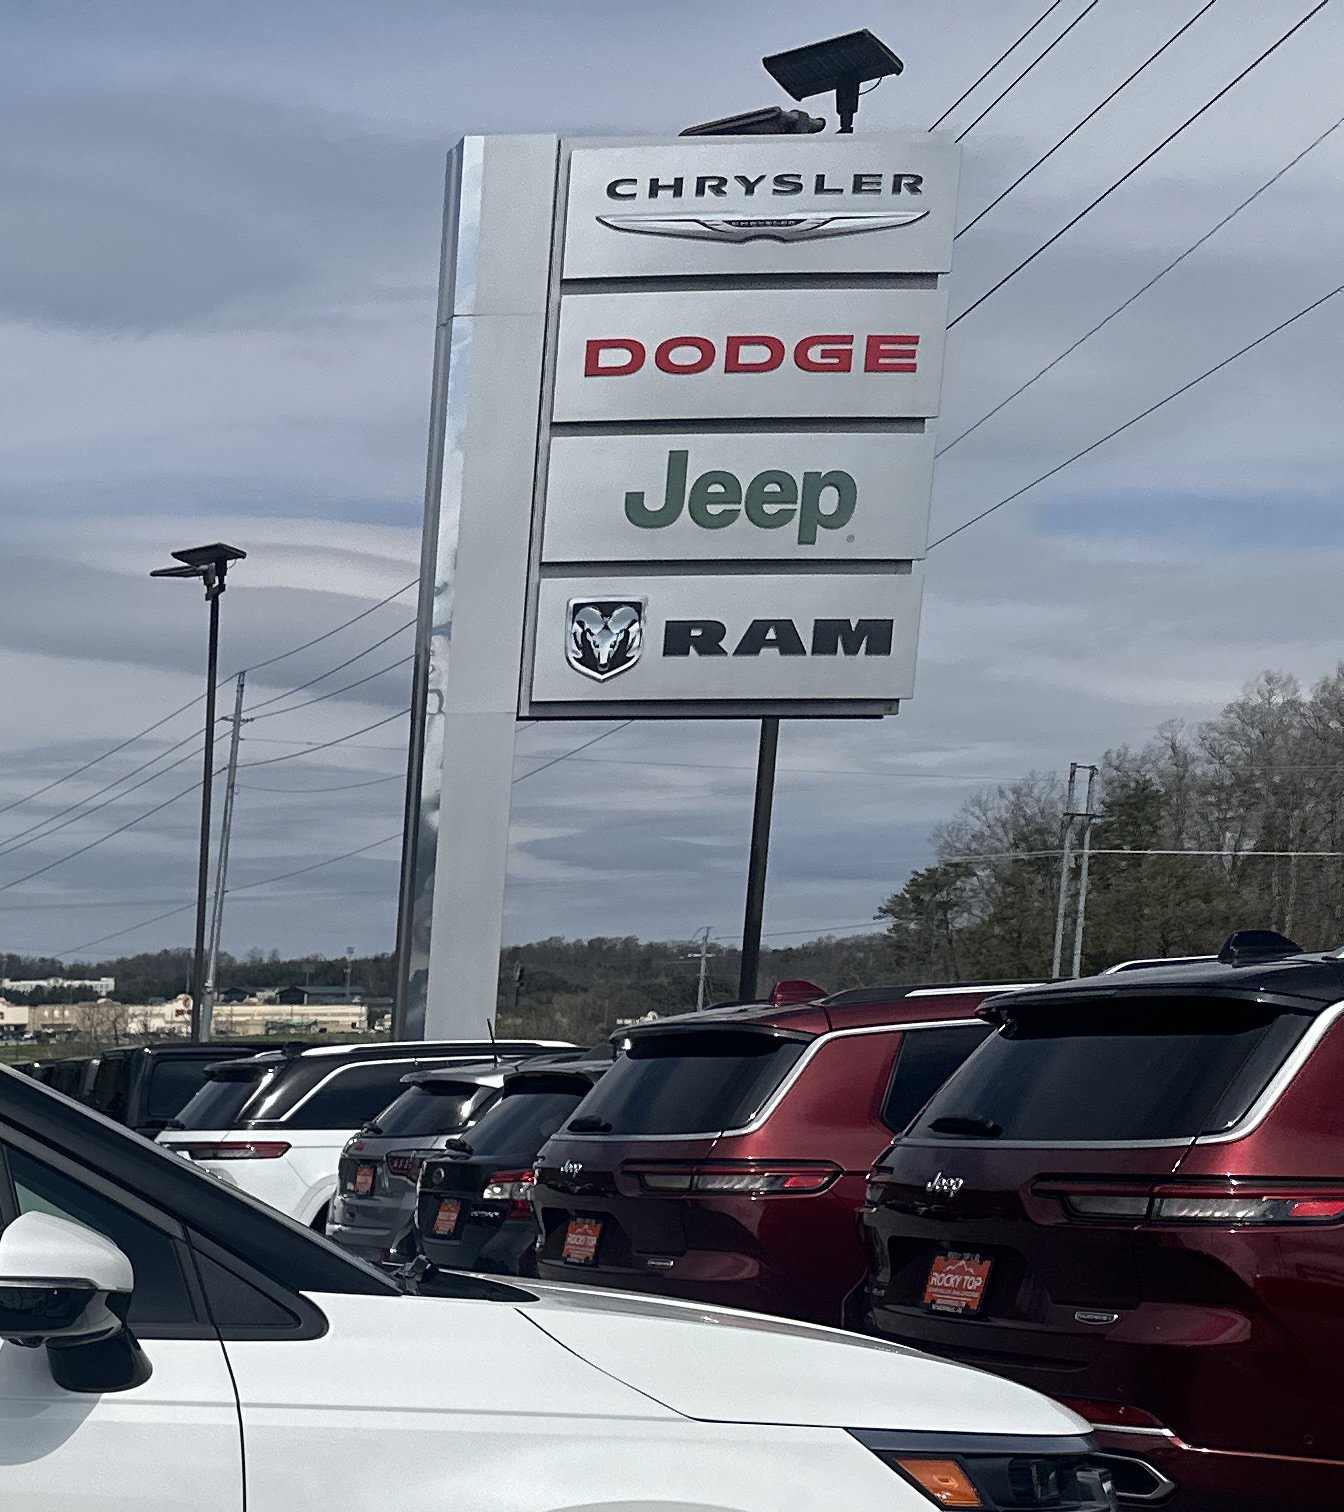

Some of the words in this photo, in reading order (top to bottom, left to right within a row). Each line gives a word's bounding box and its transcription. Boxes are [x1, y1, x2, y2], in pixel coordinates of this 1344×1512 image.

[605, 173, 925, 200] CHRYSLER
[583, 334, 921, 378] DODGE
[623, 449, 858, 545] Jeep
[662, 617, 894, 658] RAM
[925, 1171, 964, 1198] Jeep
[930, 1272, 962, 1290] ROCKY
[962, 1276, 983, 1291] TOP
